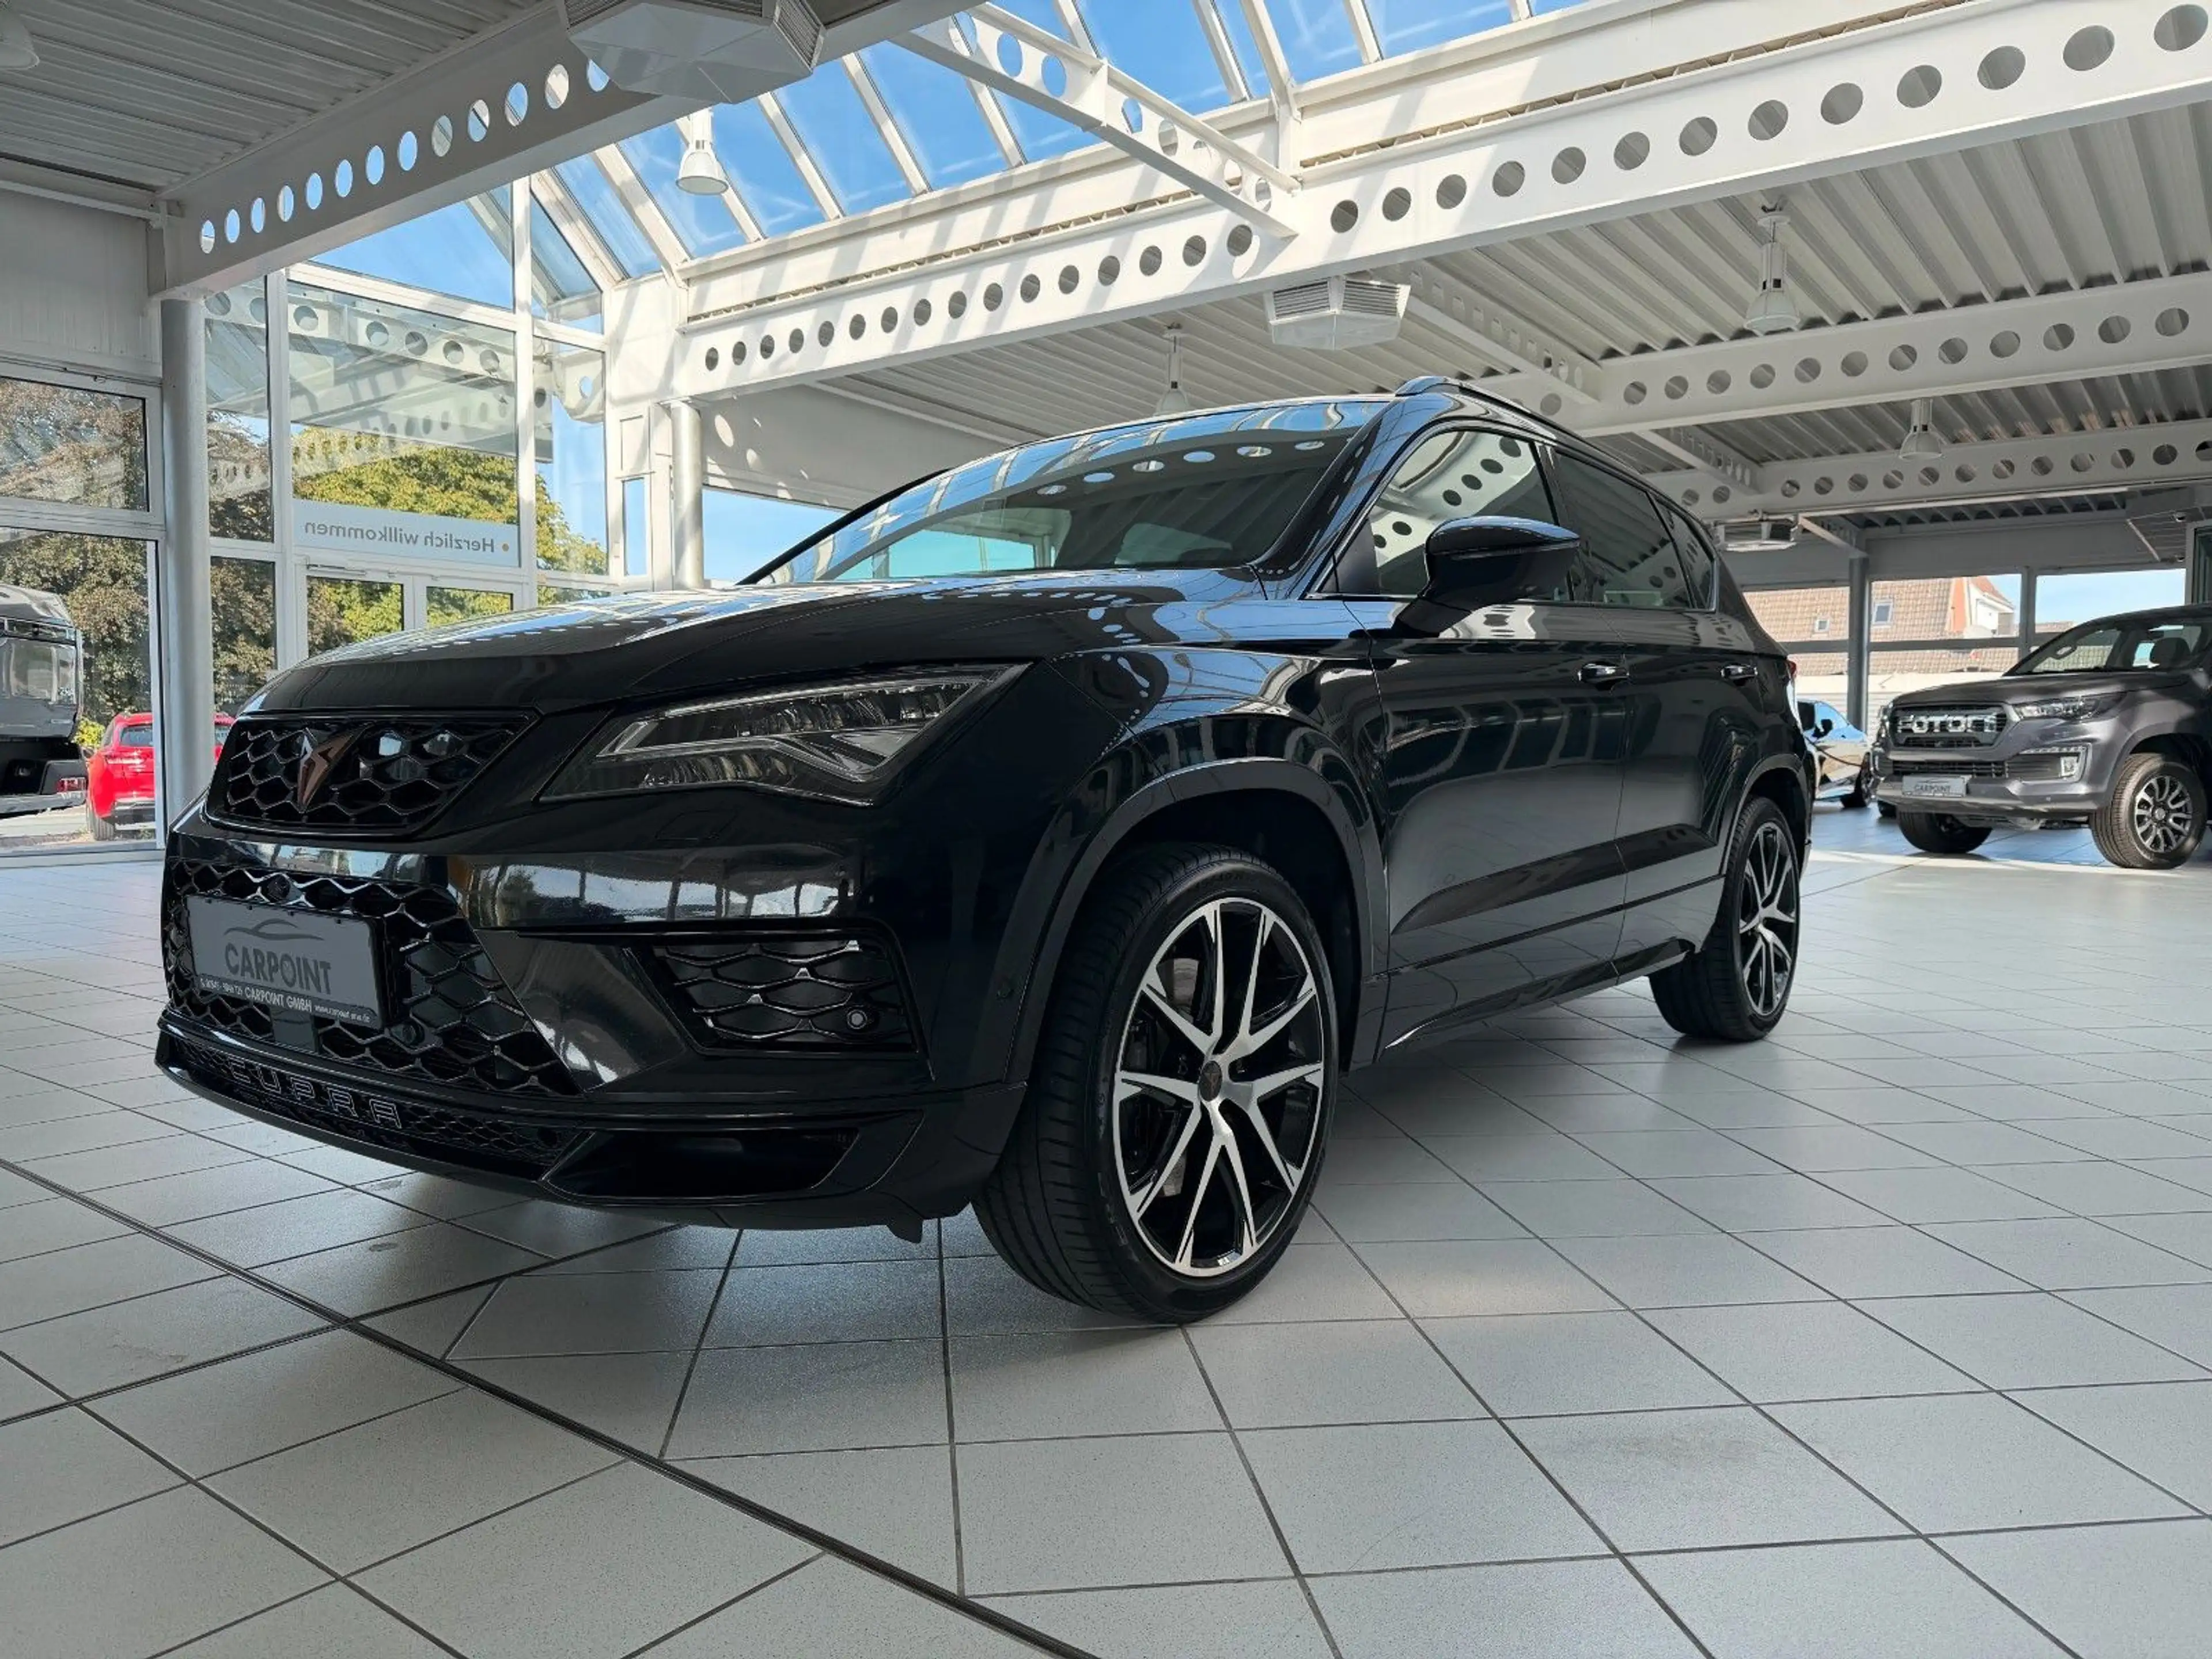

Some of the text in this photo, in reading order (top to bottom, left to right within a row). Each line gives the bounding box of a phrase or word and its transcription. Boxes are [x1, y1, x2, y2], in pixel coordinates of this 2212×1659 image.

[225, 943, 331, 995] CARPOINT
[245, 987, 284, 1007] CARPOINT
[229, 1061, 402, 1129] CUPRA
